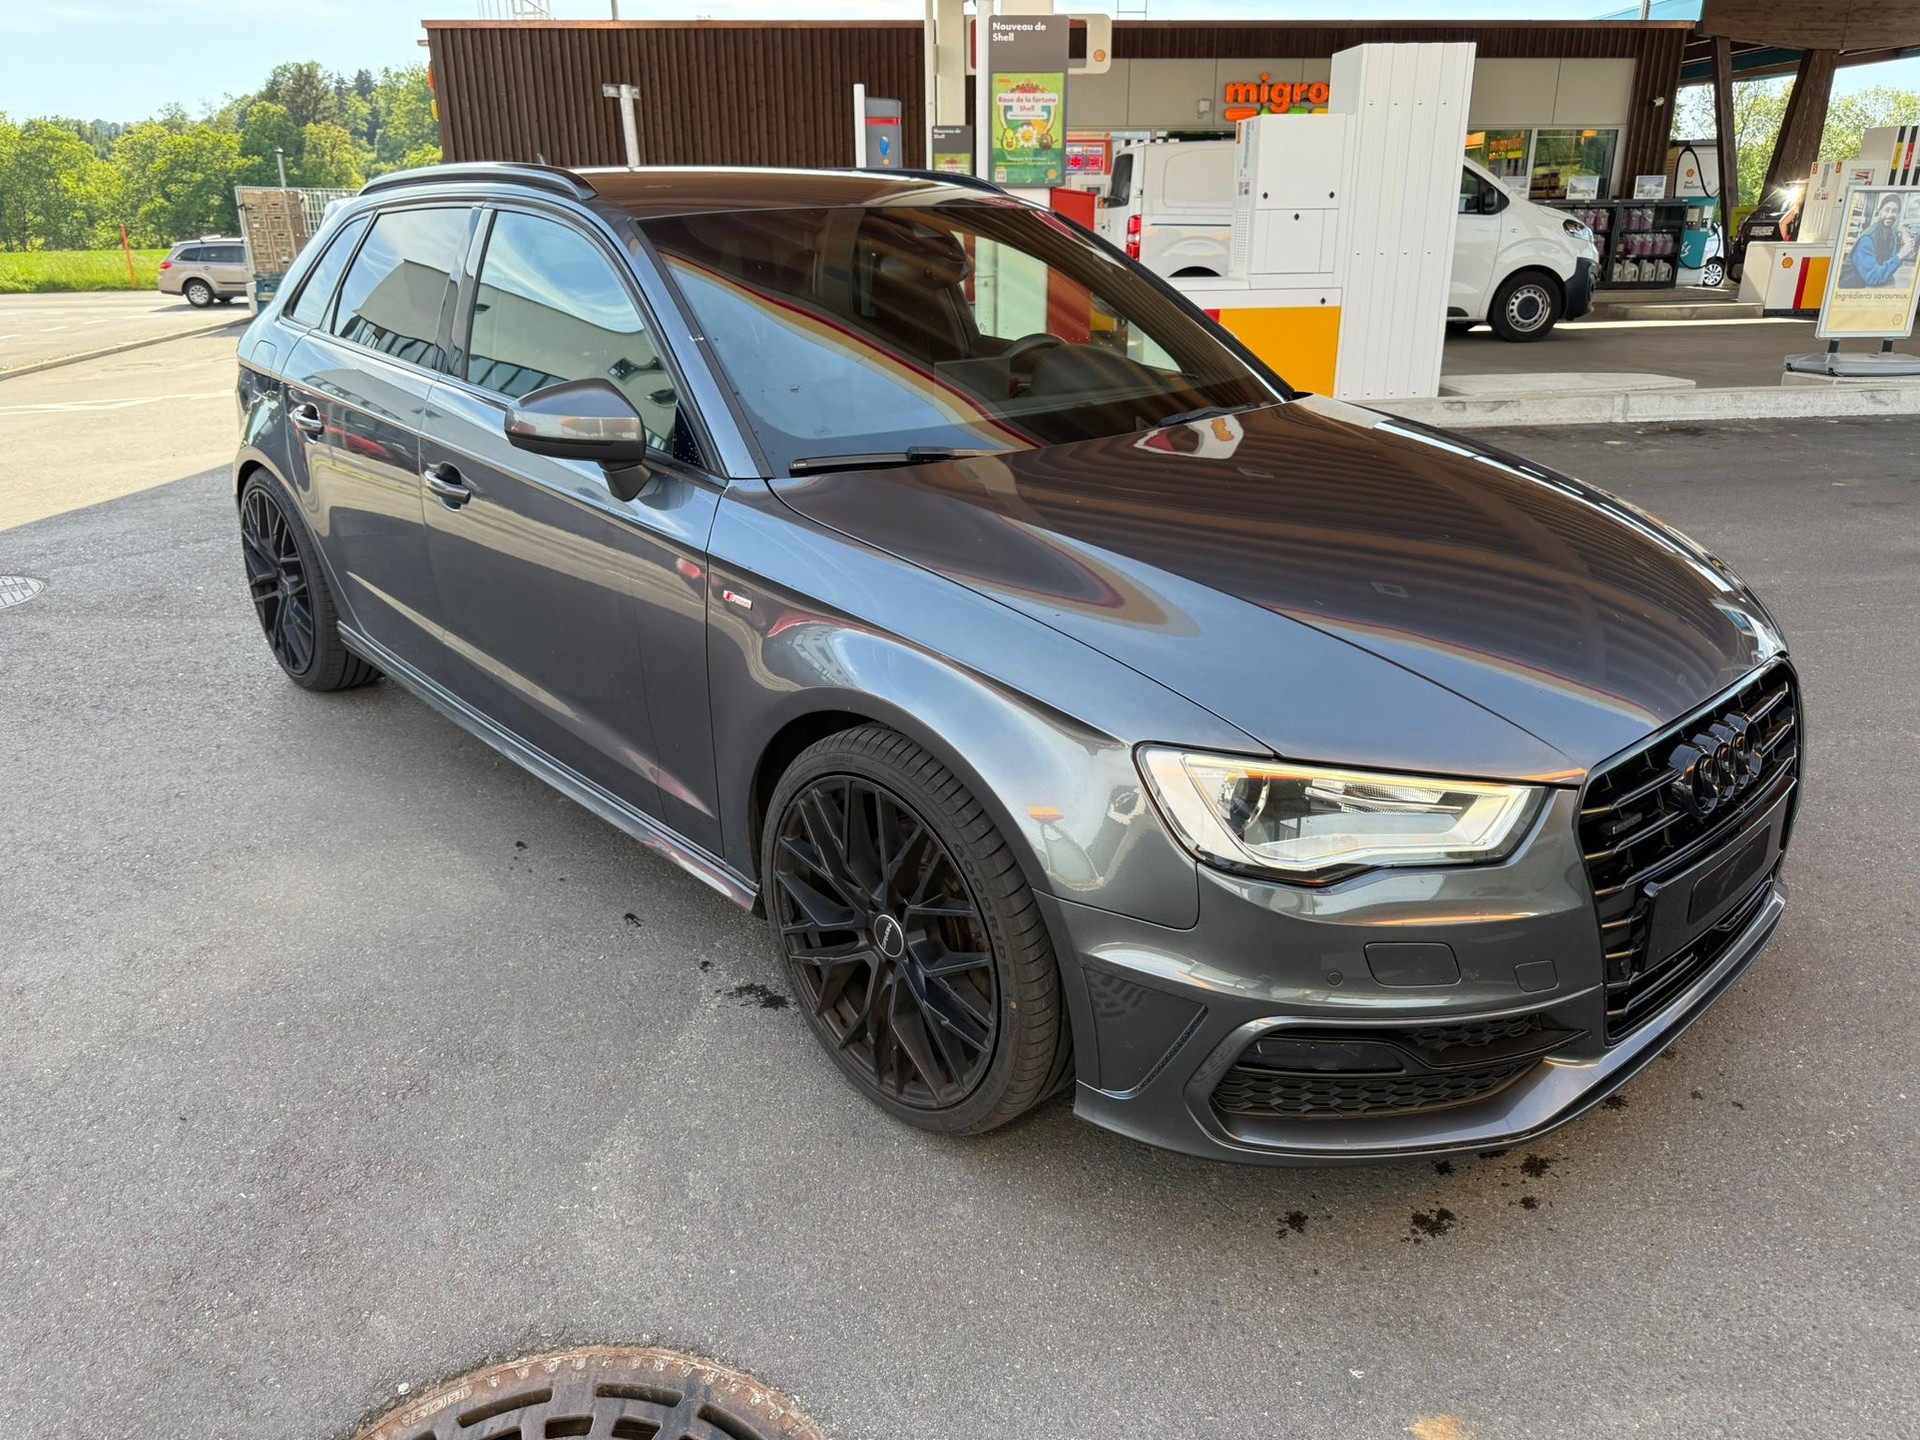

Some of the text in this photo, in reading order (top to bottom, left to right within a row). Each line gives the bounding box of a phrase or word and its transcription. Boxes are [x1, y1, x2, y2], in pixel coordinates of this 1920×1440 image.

[992, 21, 1047, 31] Nouveau de
[992, 33, 1014, 42] Shell
[1835, 291, 1872, 302] Ingrédients
